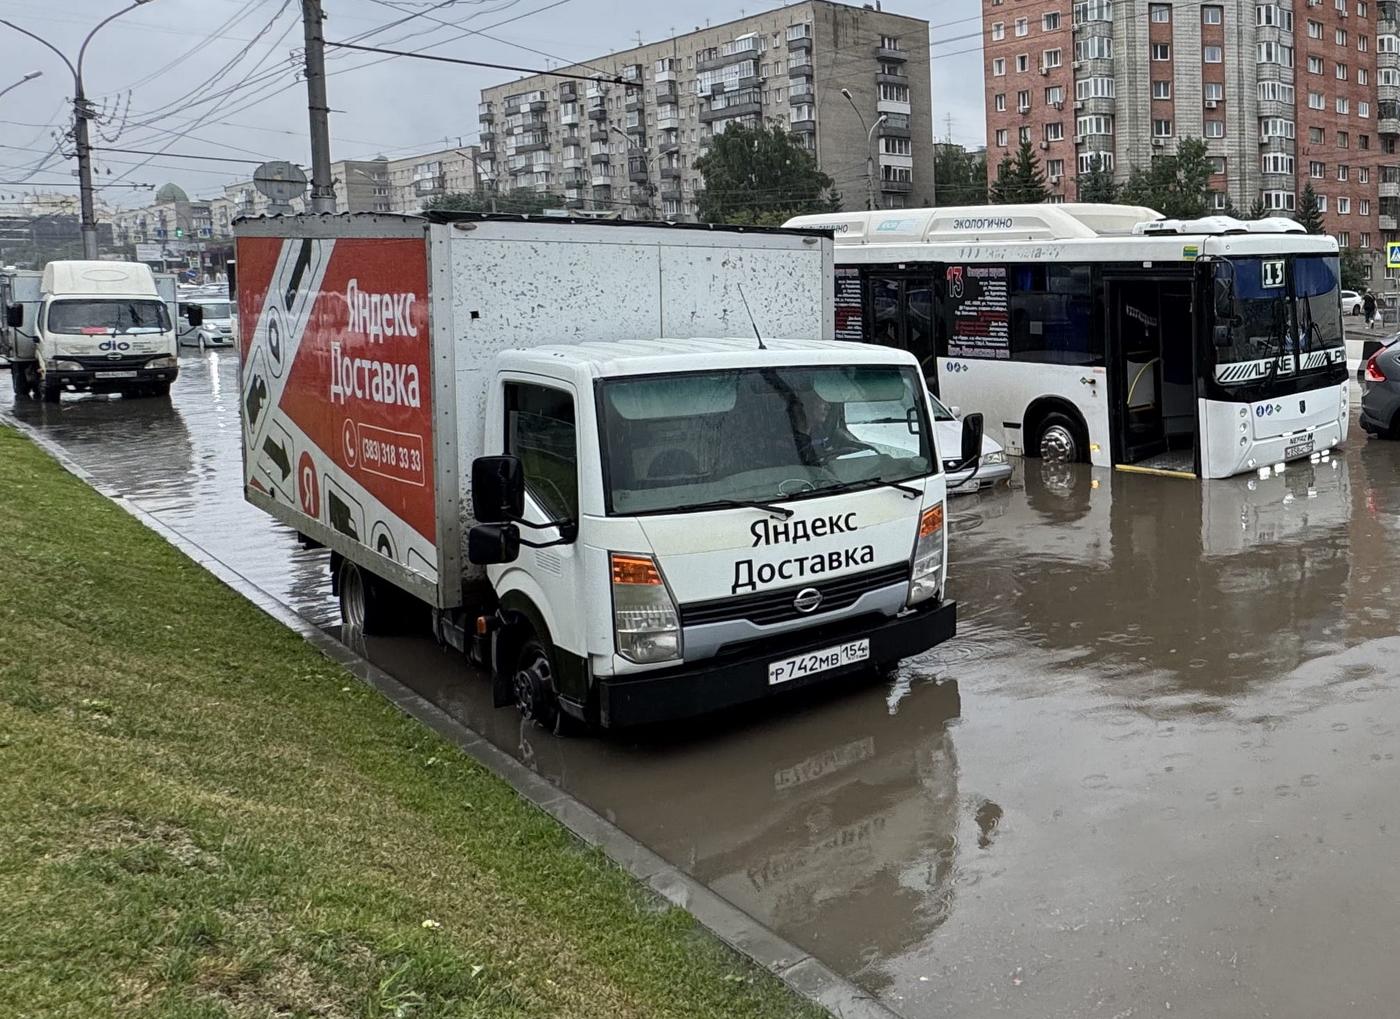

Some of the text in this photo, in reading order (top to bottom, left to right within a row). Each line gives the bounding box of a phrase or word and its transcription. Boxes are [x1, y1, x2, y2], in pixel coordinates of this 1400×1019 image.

[953, 218, 1013, 230] ЭКОЛОГИЧНО
[946, 266, 964, 298] 13
[1265, 263, 1283, 285] 13
[347, 278, 418, 344] Яндекс
[98, 340, 130, 351] dio
[330, 341, 421, 408] Доставка
[1247, 357, 1292, 377] ALPNE
[362, 437, 421, 472] (383) 318 33 33
[303, 467, 315, 515] Я
[750, 511, 858, 548] Яндекс
[731, 544, 876, 595] Доставка
[774, 641, 866, 681] Р742МВ 154
